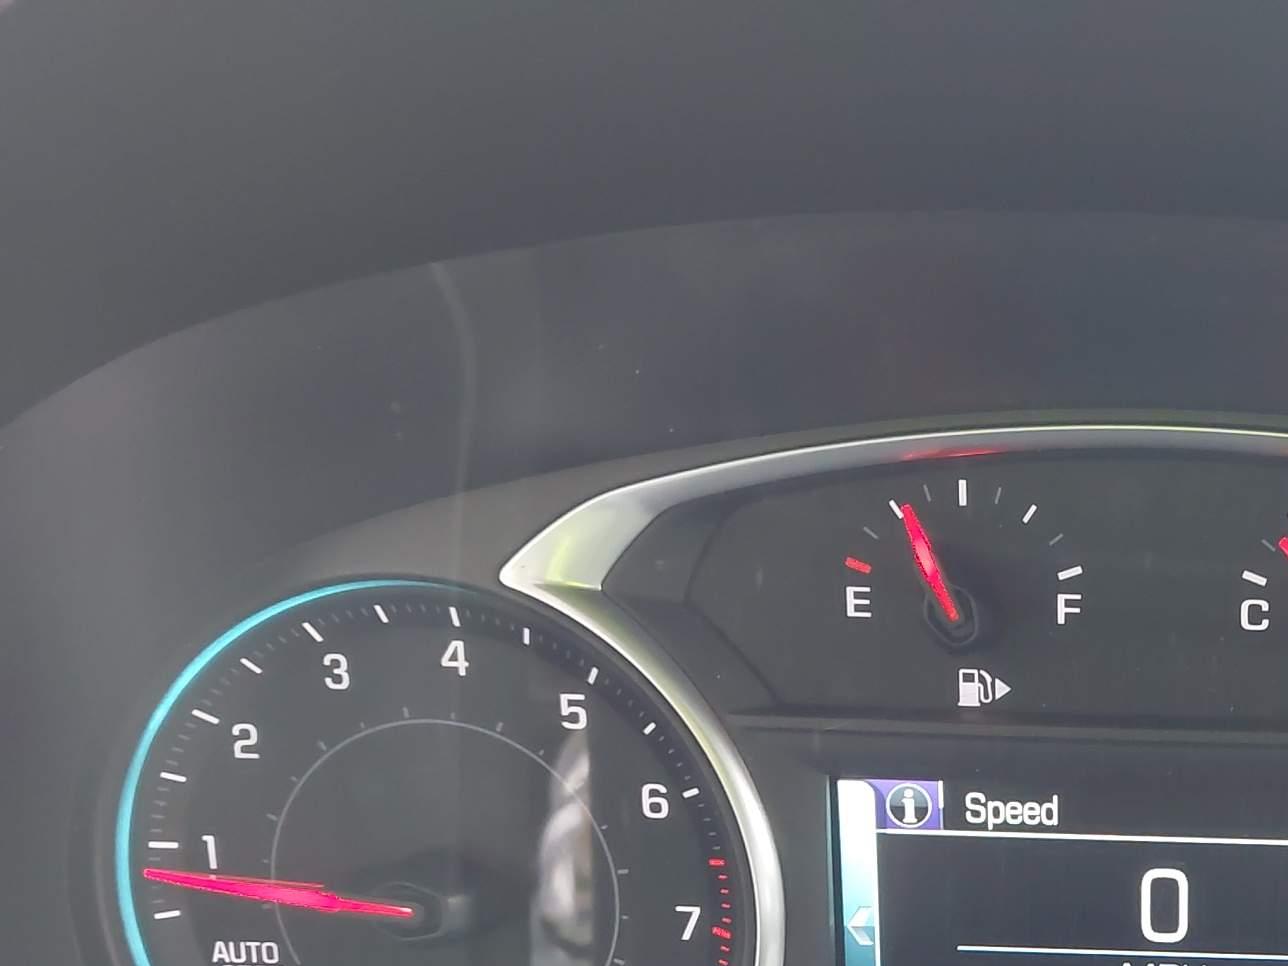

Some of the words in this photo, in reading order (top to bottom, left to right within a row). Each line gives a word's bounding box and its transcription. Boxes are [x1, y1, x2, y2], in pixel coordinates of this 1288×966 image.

[846, 586, 872, 618] E
[1057, 593, 1082, 625] F
[1240, 600, 1270, 632] C
[323, 652, 350, 690] 3
[440, 640, 470, 676] 4
[559, 693, 588, 730] 5
[233, 723, 260, 760] 2
[640, 783, 670, 820] 6
[965, 792, 1060, 829] Speed
[201, 834, 218, 870] 1
[674, 904, 701, 942] 7
[1139, 867, 1189, 943] 0
[211, 941, 279, 965] AUTO
